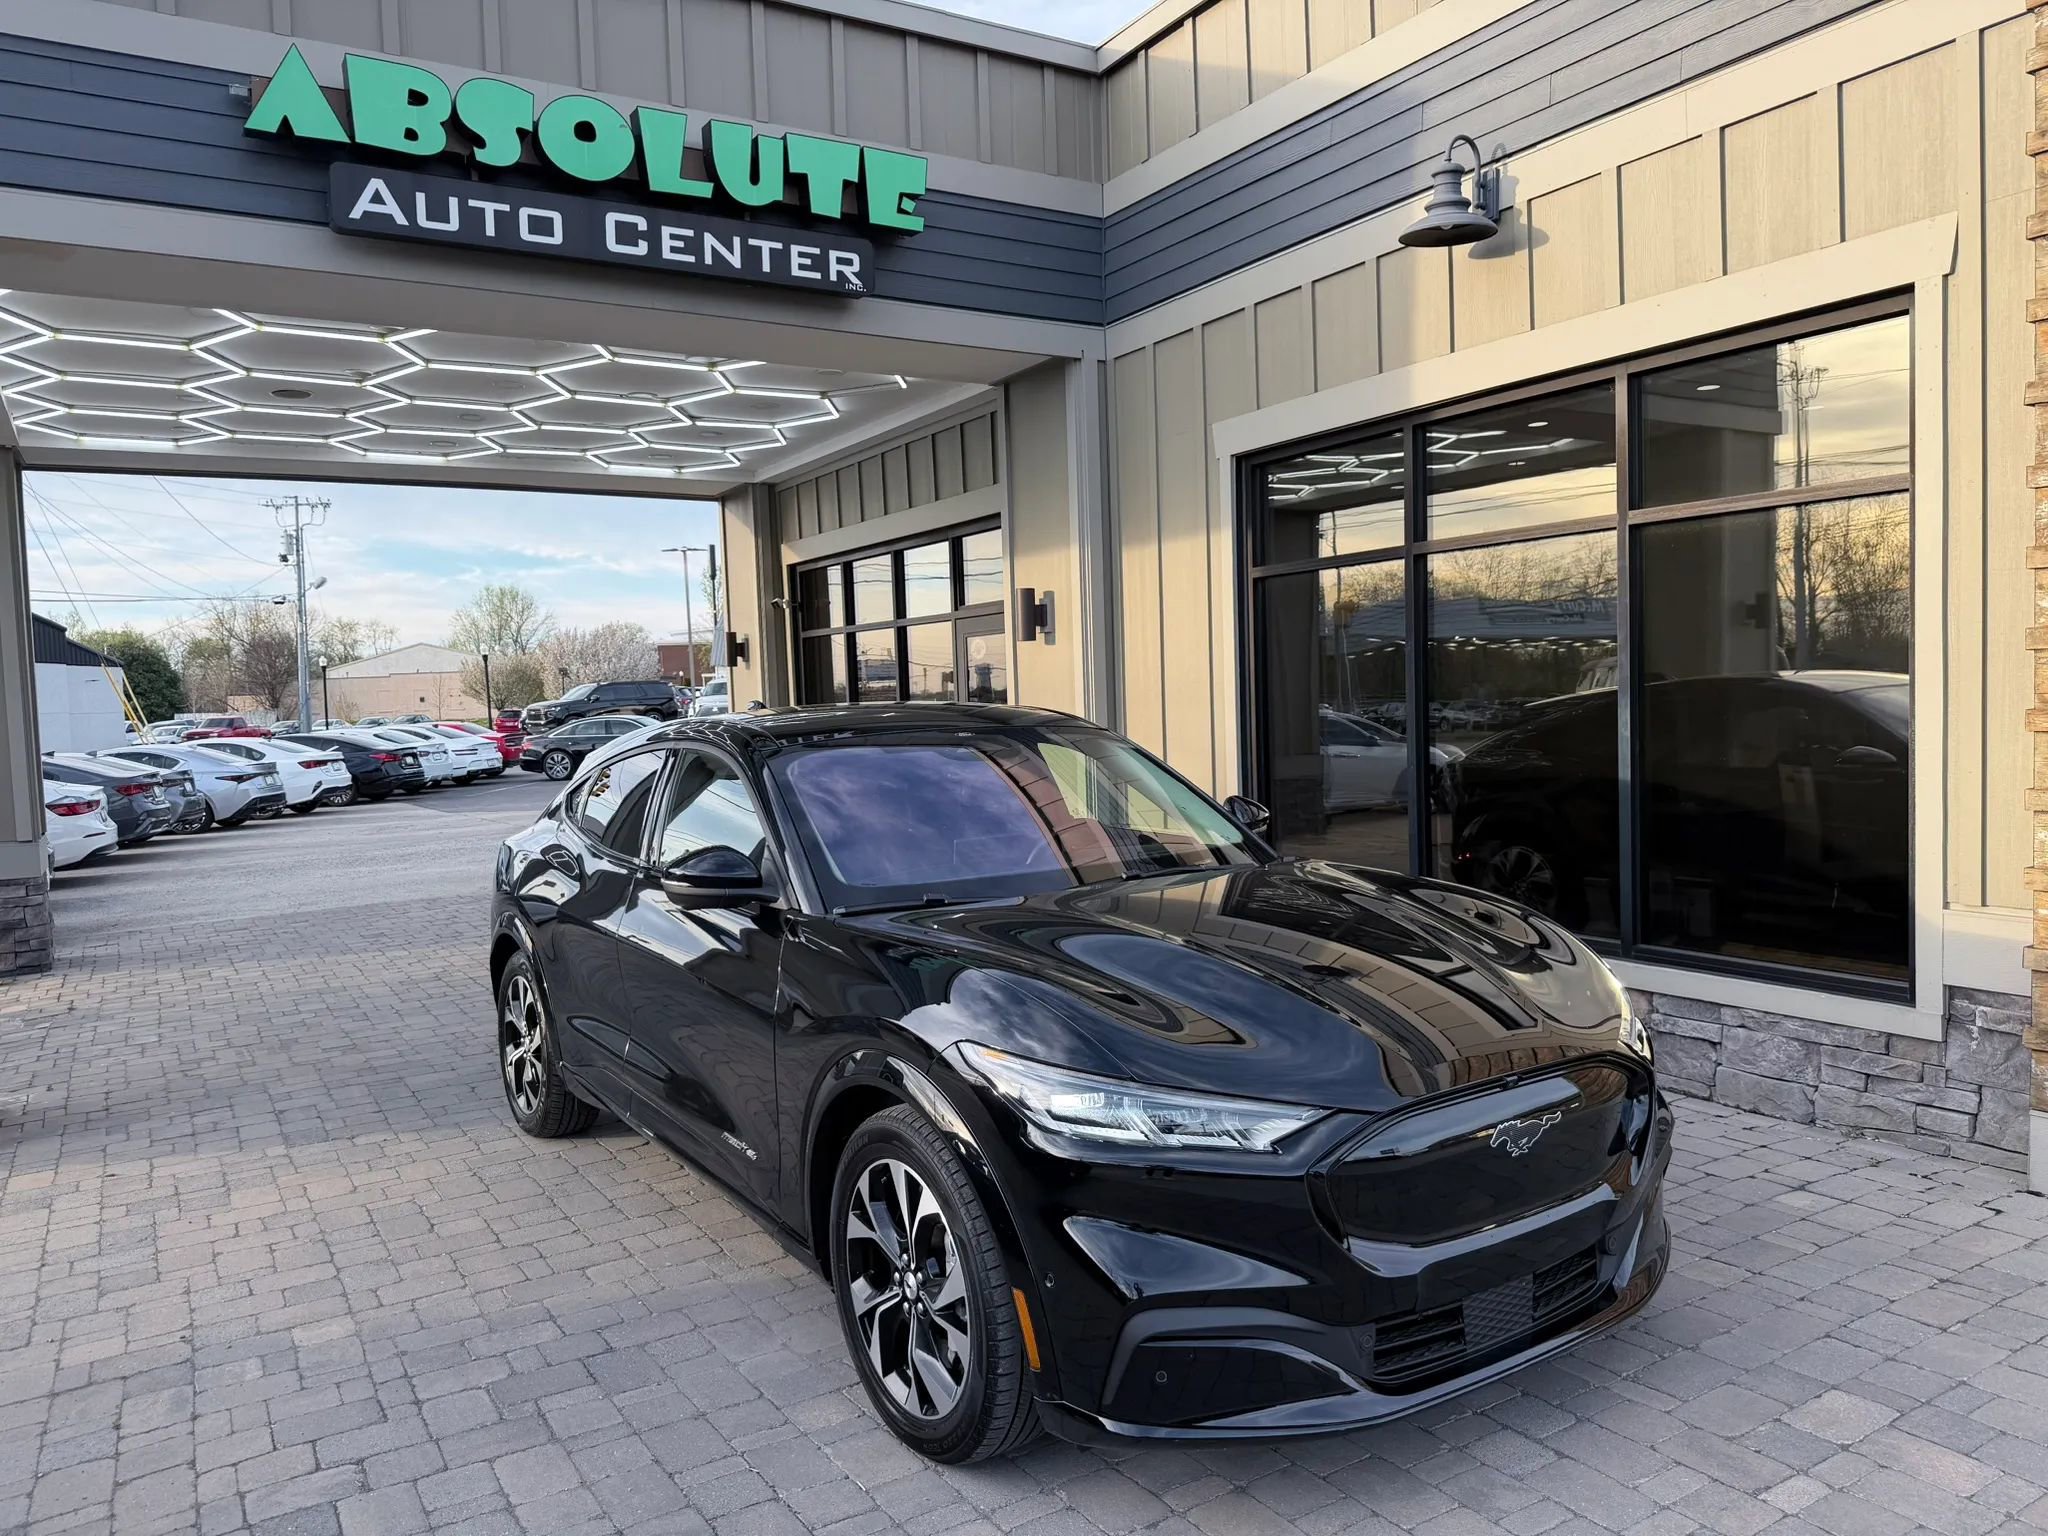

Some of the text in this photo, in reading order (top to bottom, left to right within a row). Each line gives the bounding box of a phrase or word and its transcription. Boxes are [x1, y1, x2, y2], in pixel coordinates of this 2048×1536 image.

[243, 42, 928, 233] ABSOLUTE
[348, 177, 863, 286] AUTO CENTER
[845, 282, 867, 292] INC.
